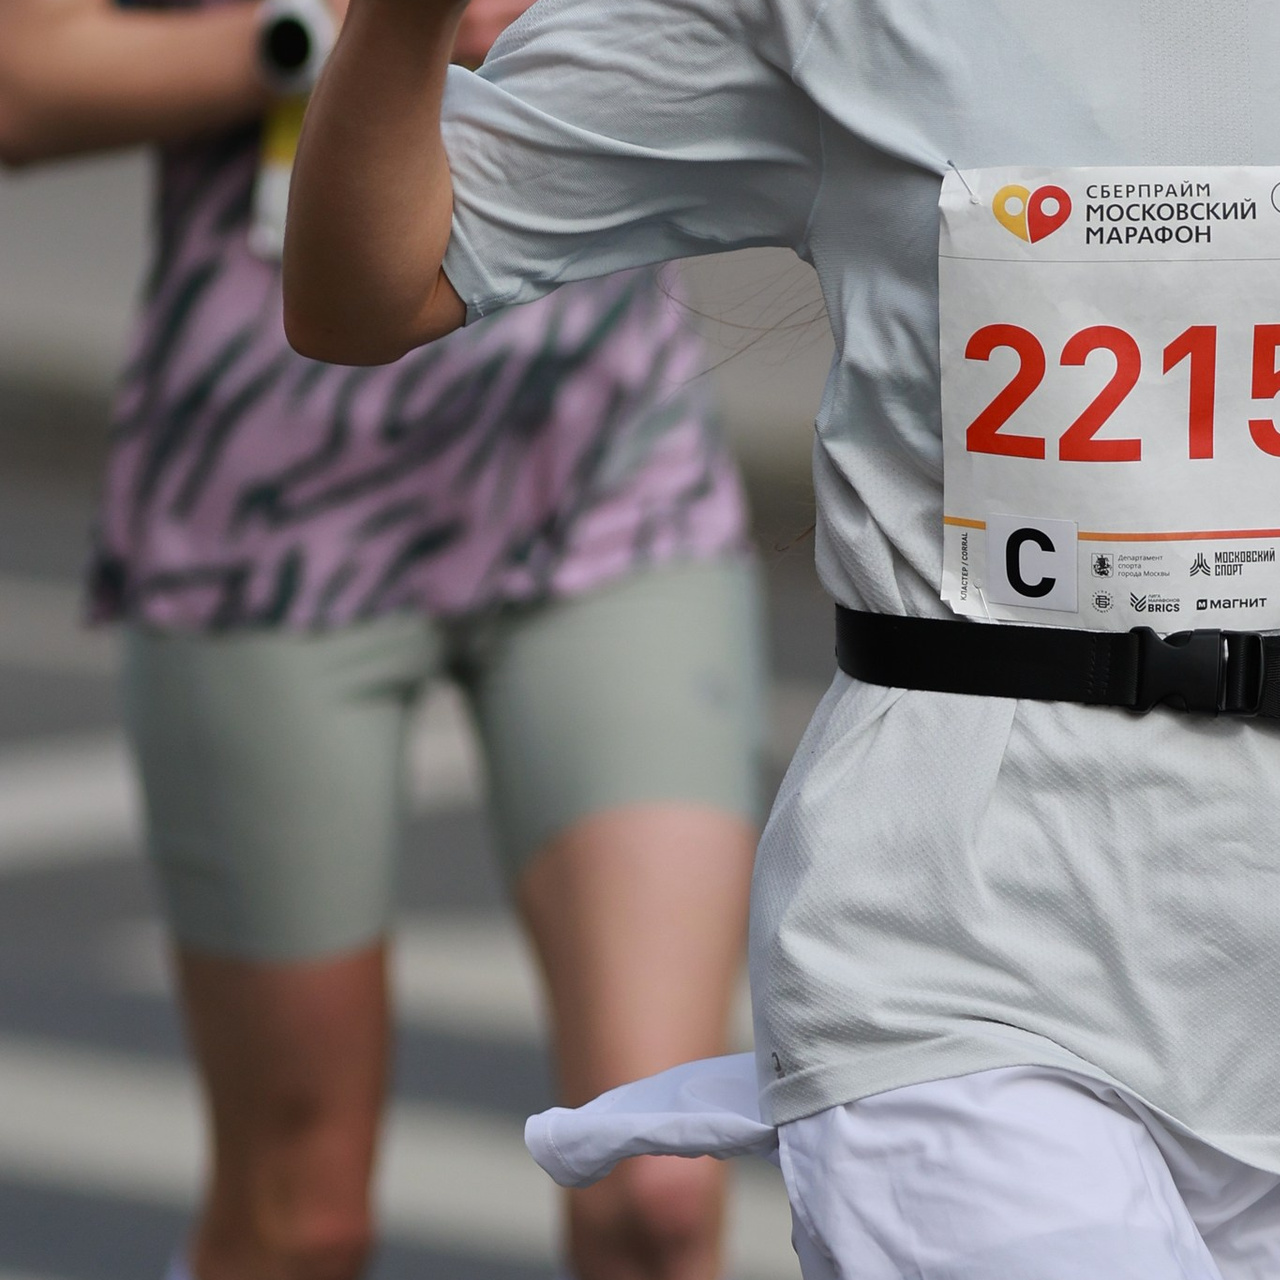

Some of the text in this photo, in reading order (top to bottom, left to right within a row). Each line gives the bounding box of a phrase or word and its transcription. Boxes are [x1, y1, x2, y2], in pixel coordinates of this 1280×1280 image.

[1086, 180, 1211, 199] СБЕРПРАЙМ
[1086, 198, 1257, 222] МОСКОВСКИЙ
[1085, 225, 1211, 245] МАРАФОН
[961, 532, 969, 561] CORRAL
[1214, 547, 1276, 563] МОСКОВСКИЙ
[1005, 527, 1056, 598] C
[1118, 554, 1163, 562] Департамент
[1118, 562, 1142, 570] спорта
[1214, 563, 1243, 576] СПОРТ
[1148, 603, 1180, 613] BRICS
